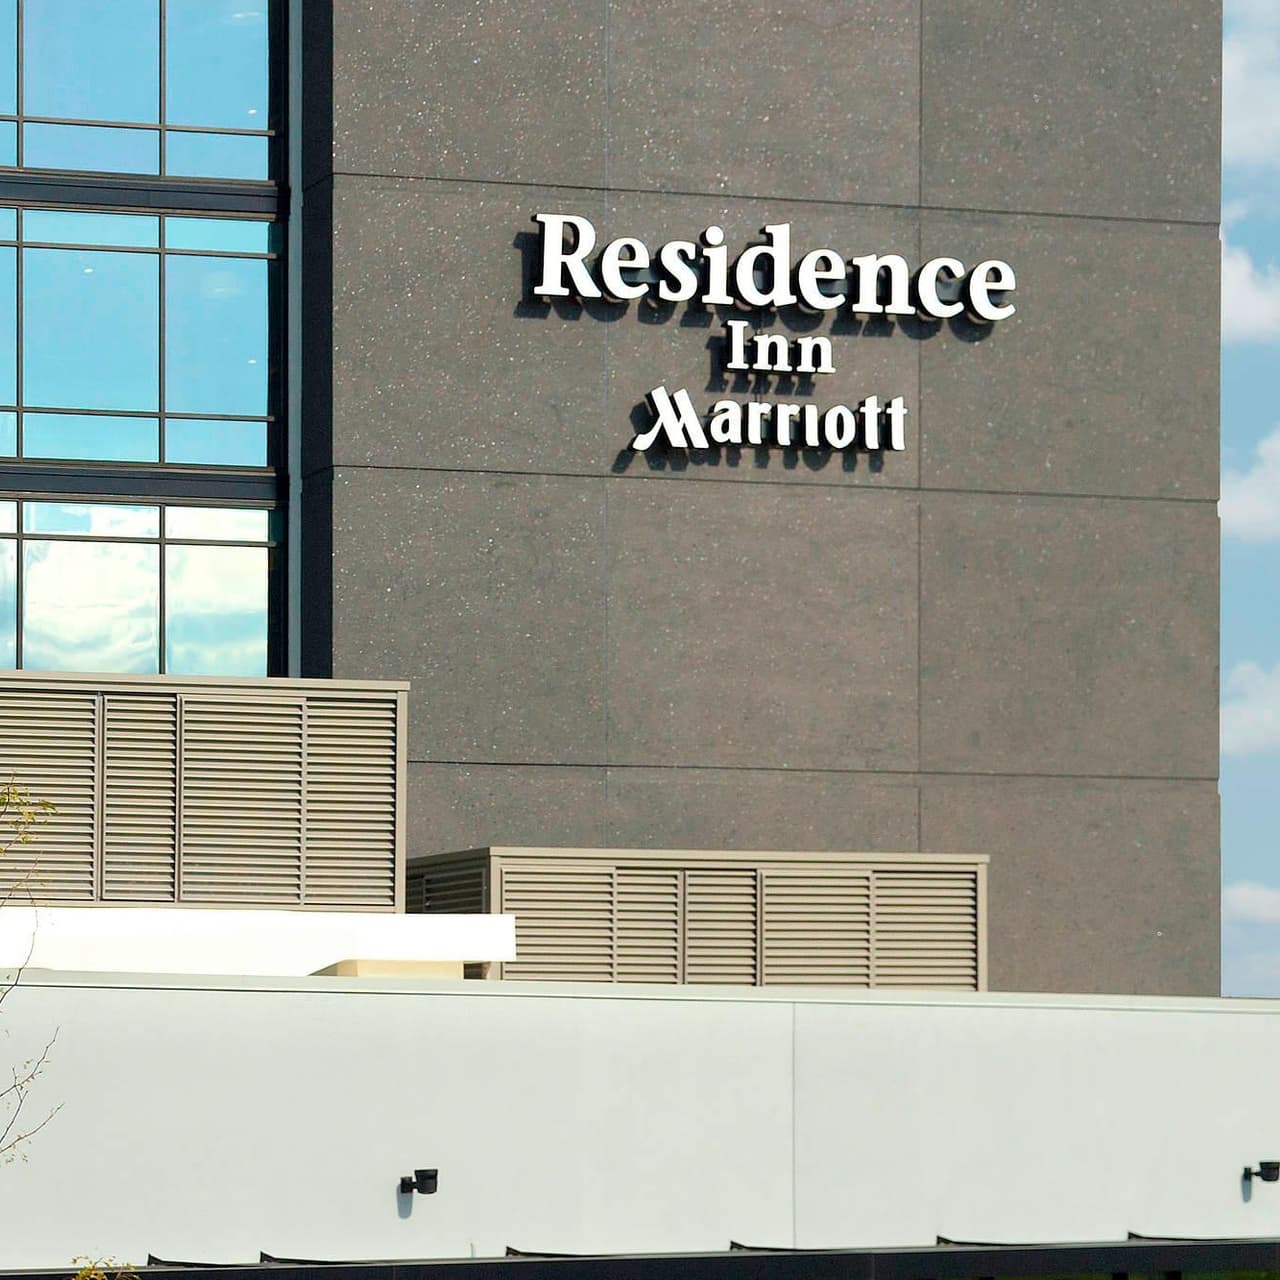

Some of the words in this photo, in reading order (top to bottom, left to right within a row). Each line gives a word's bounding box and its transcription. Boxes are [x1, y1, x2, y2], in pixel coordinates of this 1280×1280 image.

[534, 213, 1017, 320] Residence
[727, 320, 836, 373] Inn
[633, 386, 908, 451] Marriott
